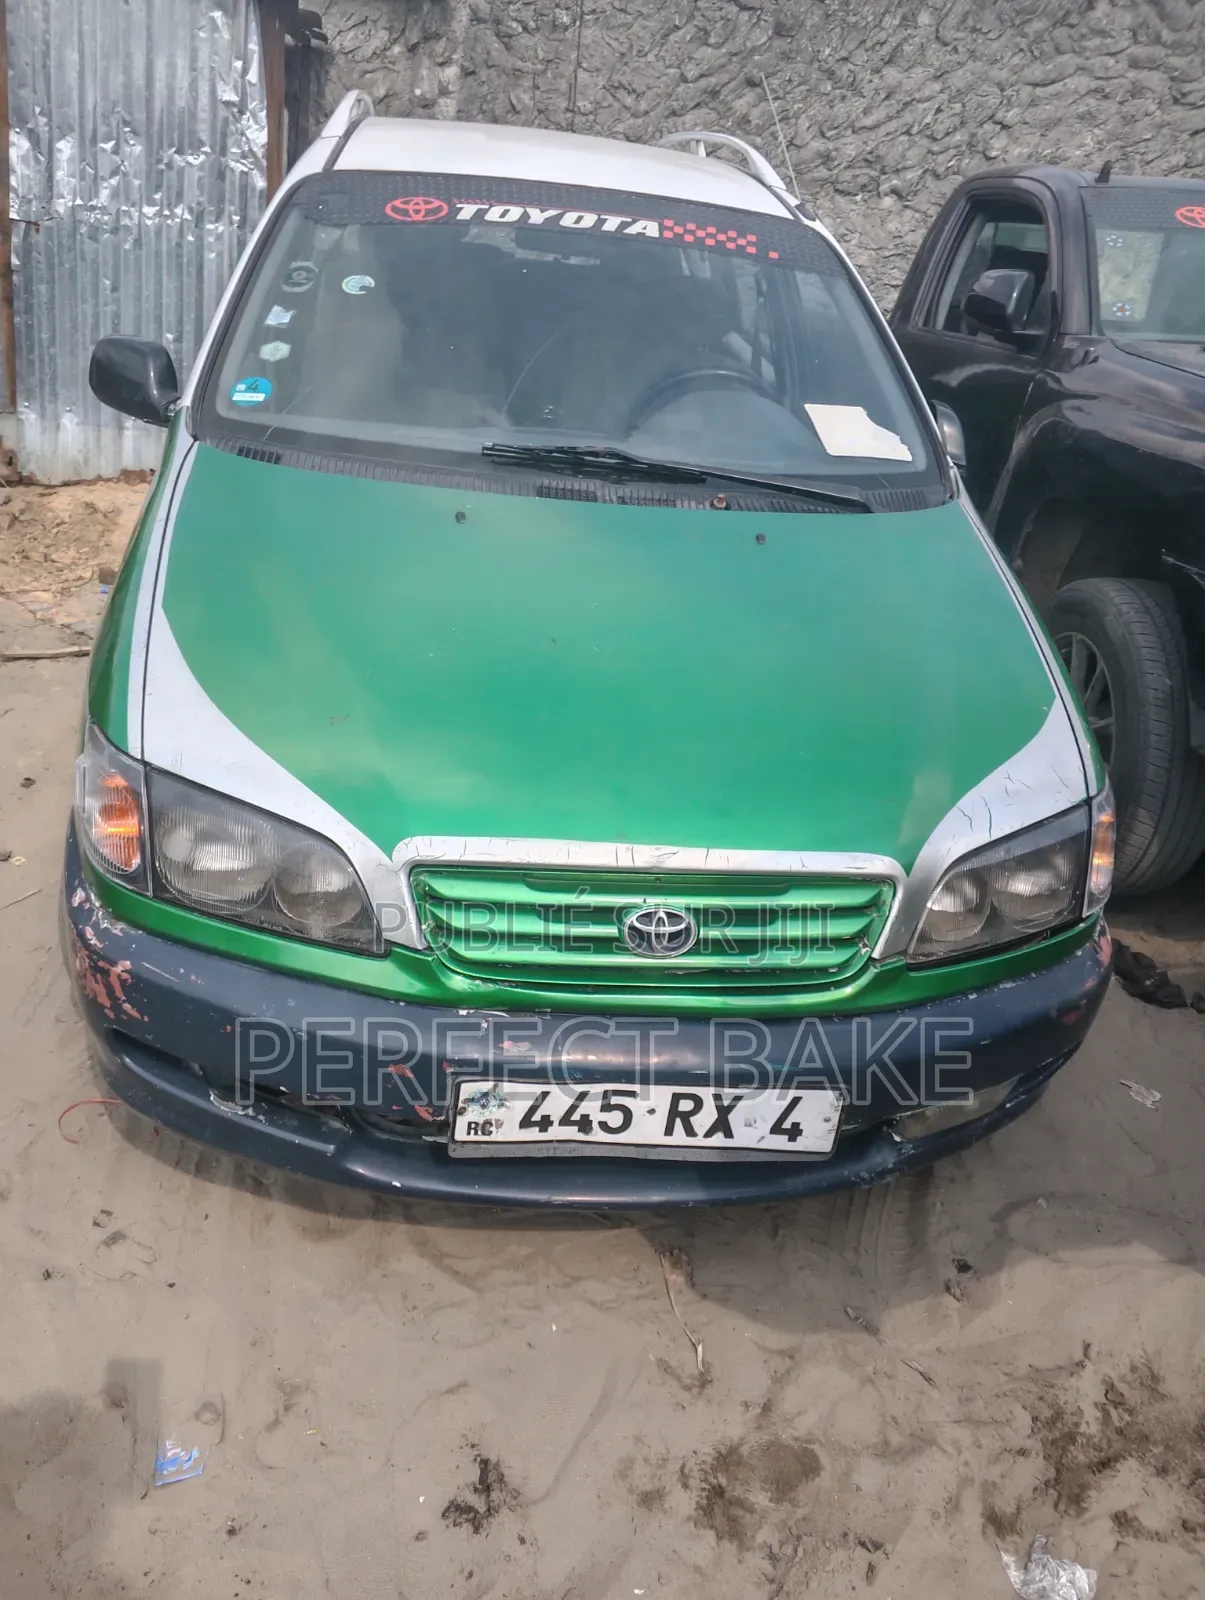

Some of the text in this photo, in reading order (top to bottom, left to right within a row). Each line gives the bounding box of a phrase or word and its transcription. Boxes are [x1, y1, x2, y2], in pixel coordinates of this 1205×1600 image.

[454, 203, 660, 238] TOYOTA
[518, 1089, 640, 1136] 445
[663, 1092, 744, 1140] RX
[769, 1096, 804, 1143] 4
